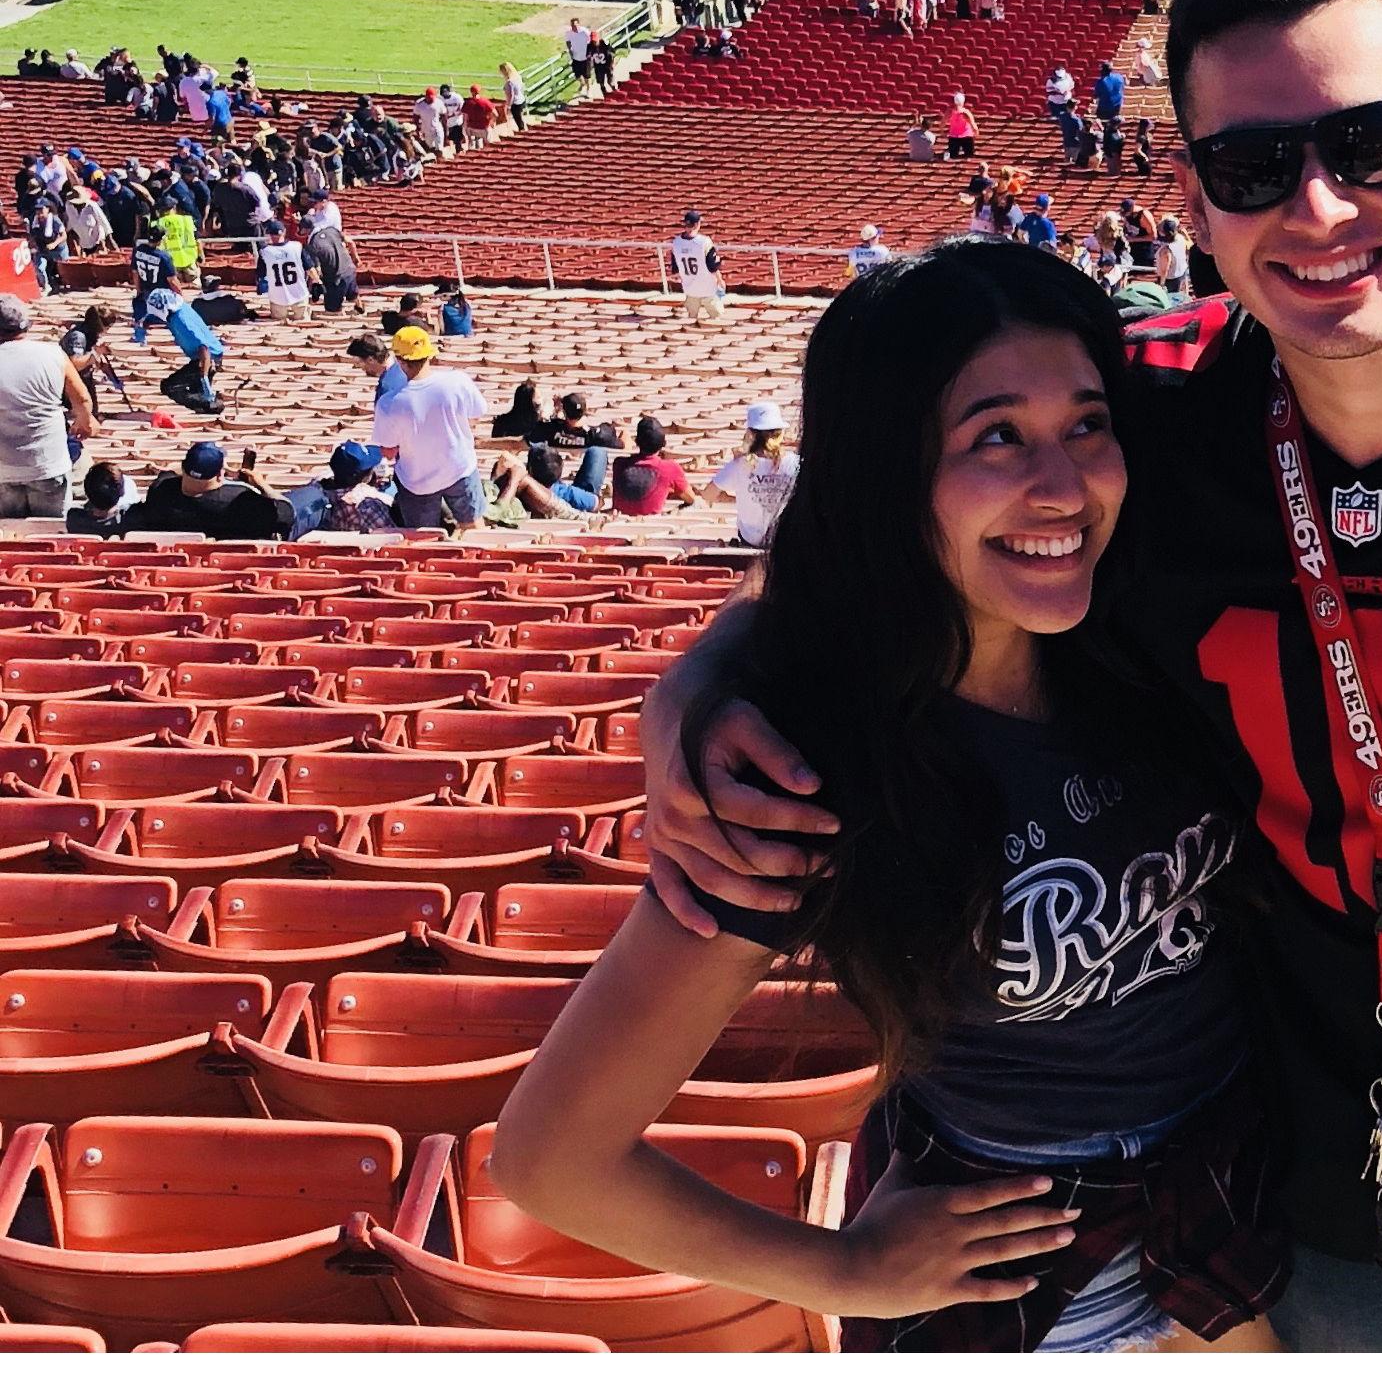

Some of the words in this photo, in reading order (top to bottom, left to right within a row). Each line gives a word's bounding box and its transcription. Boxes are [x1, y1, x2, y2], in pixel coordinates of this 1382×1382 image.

[271, 260, 298, 287] 16
[681, 256, 699, 276] 16
[1276, 439, 1328, 580] 49ERS
[1338, 510, 1374, 536] NFL
